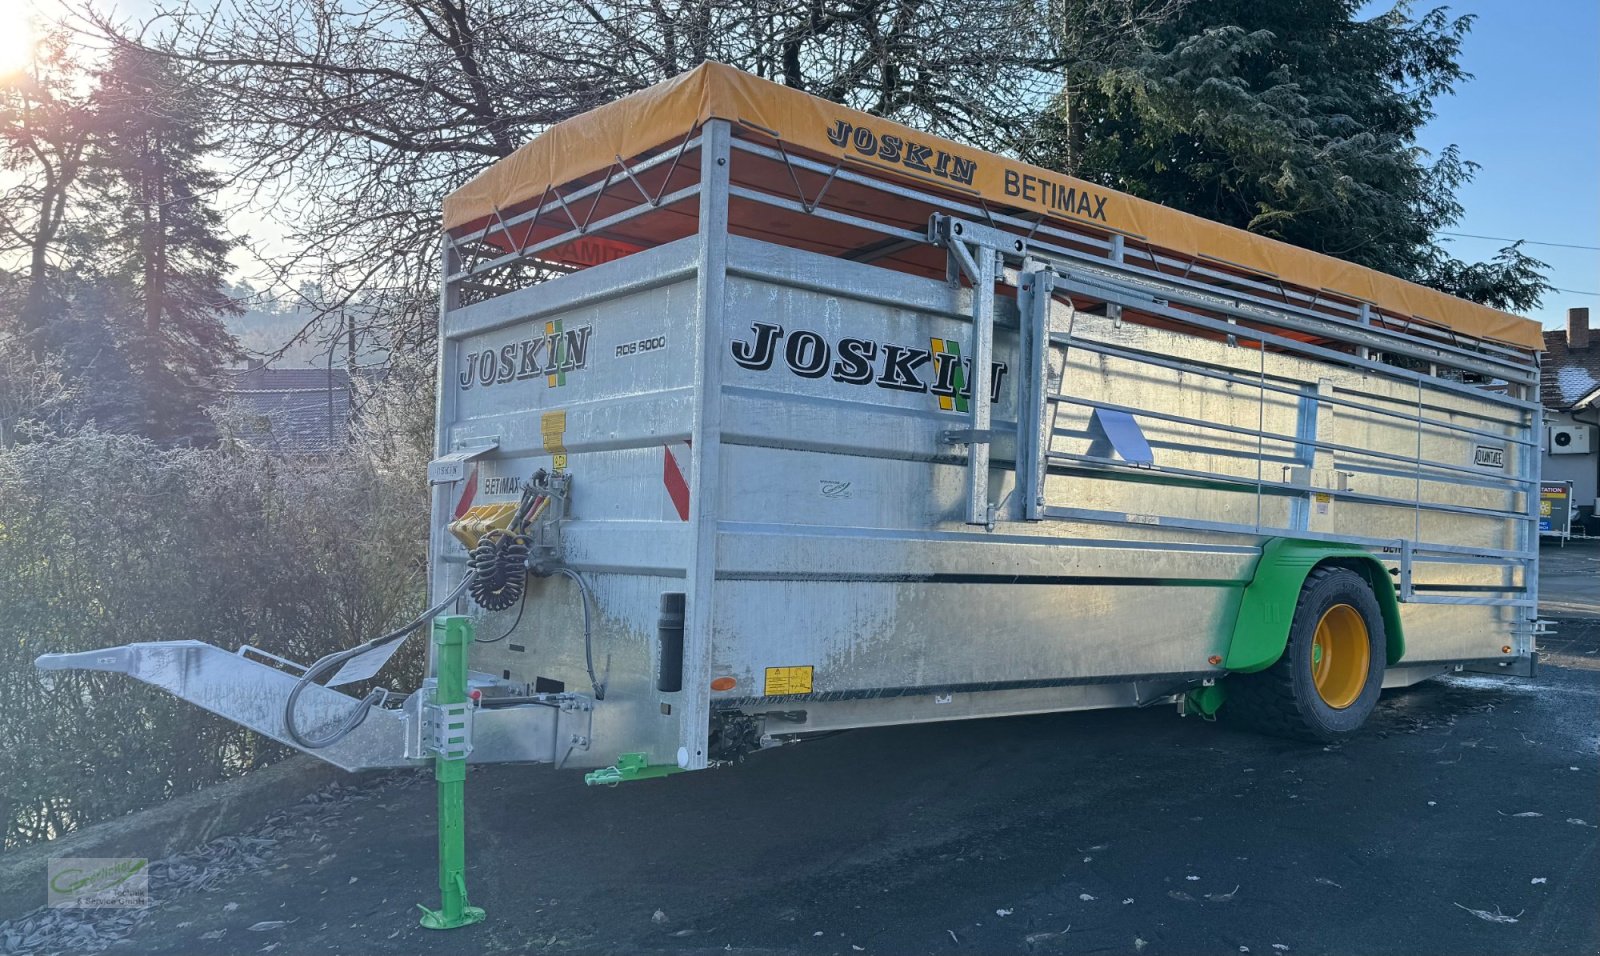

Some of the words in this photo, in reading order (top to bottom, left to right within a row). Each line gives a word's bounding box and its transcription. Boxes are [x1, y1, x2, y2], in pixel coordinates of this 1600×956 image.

[827, 118, 978, 186] JOSKIN
[1004, 169, 1108, 222] BETIMAX
[459, 325, 592, 390] JOSKIN
[615, 343, 637, 357] RDS
[638, 336, 666, 351] 6000
[730, 320, 1008, 403] JOSKIN
[484, 477, 520, 495] BETIMAX
